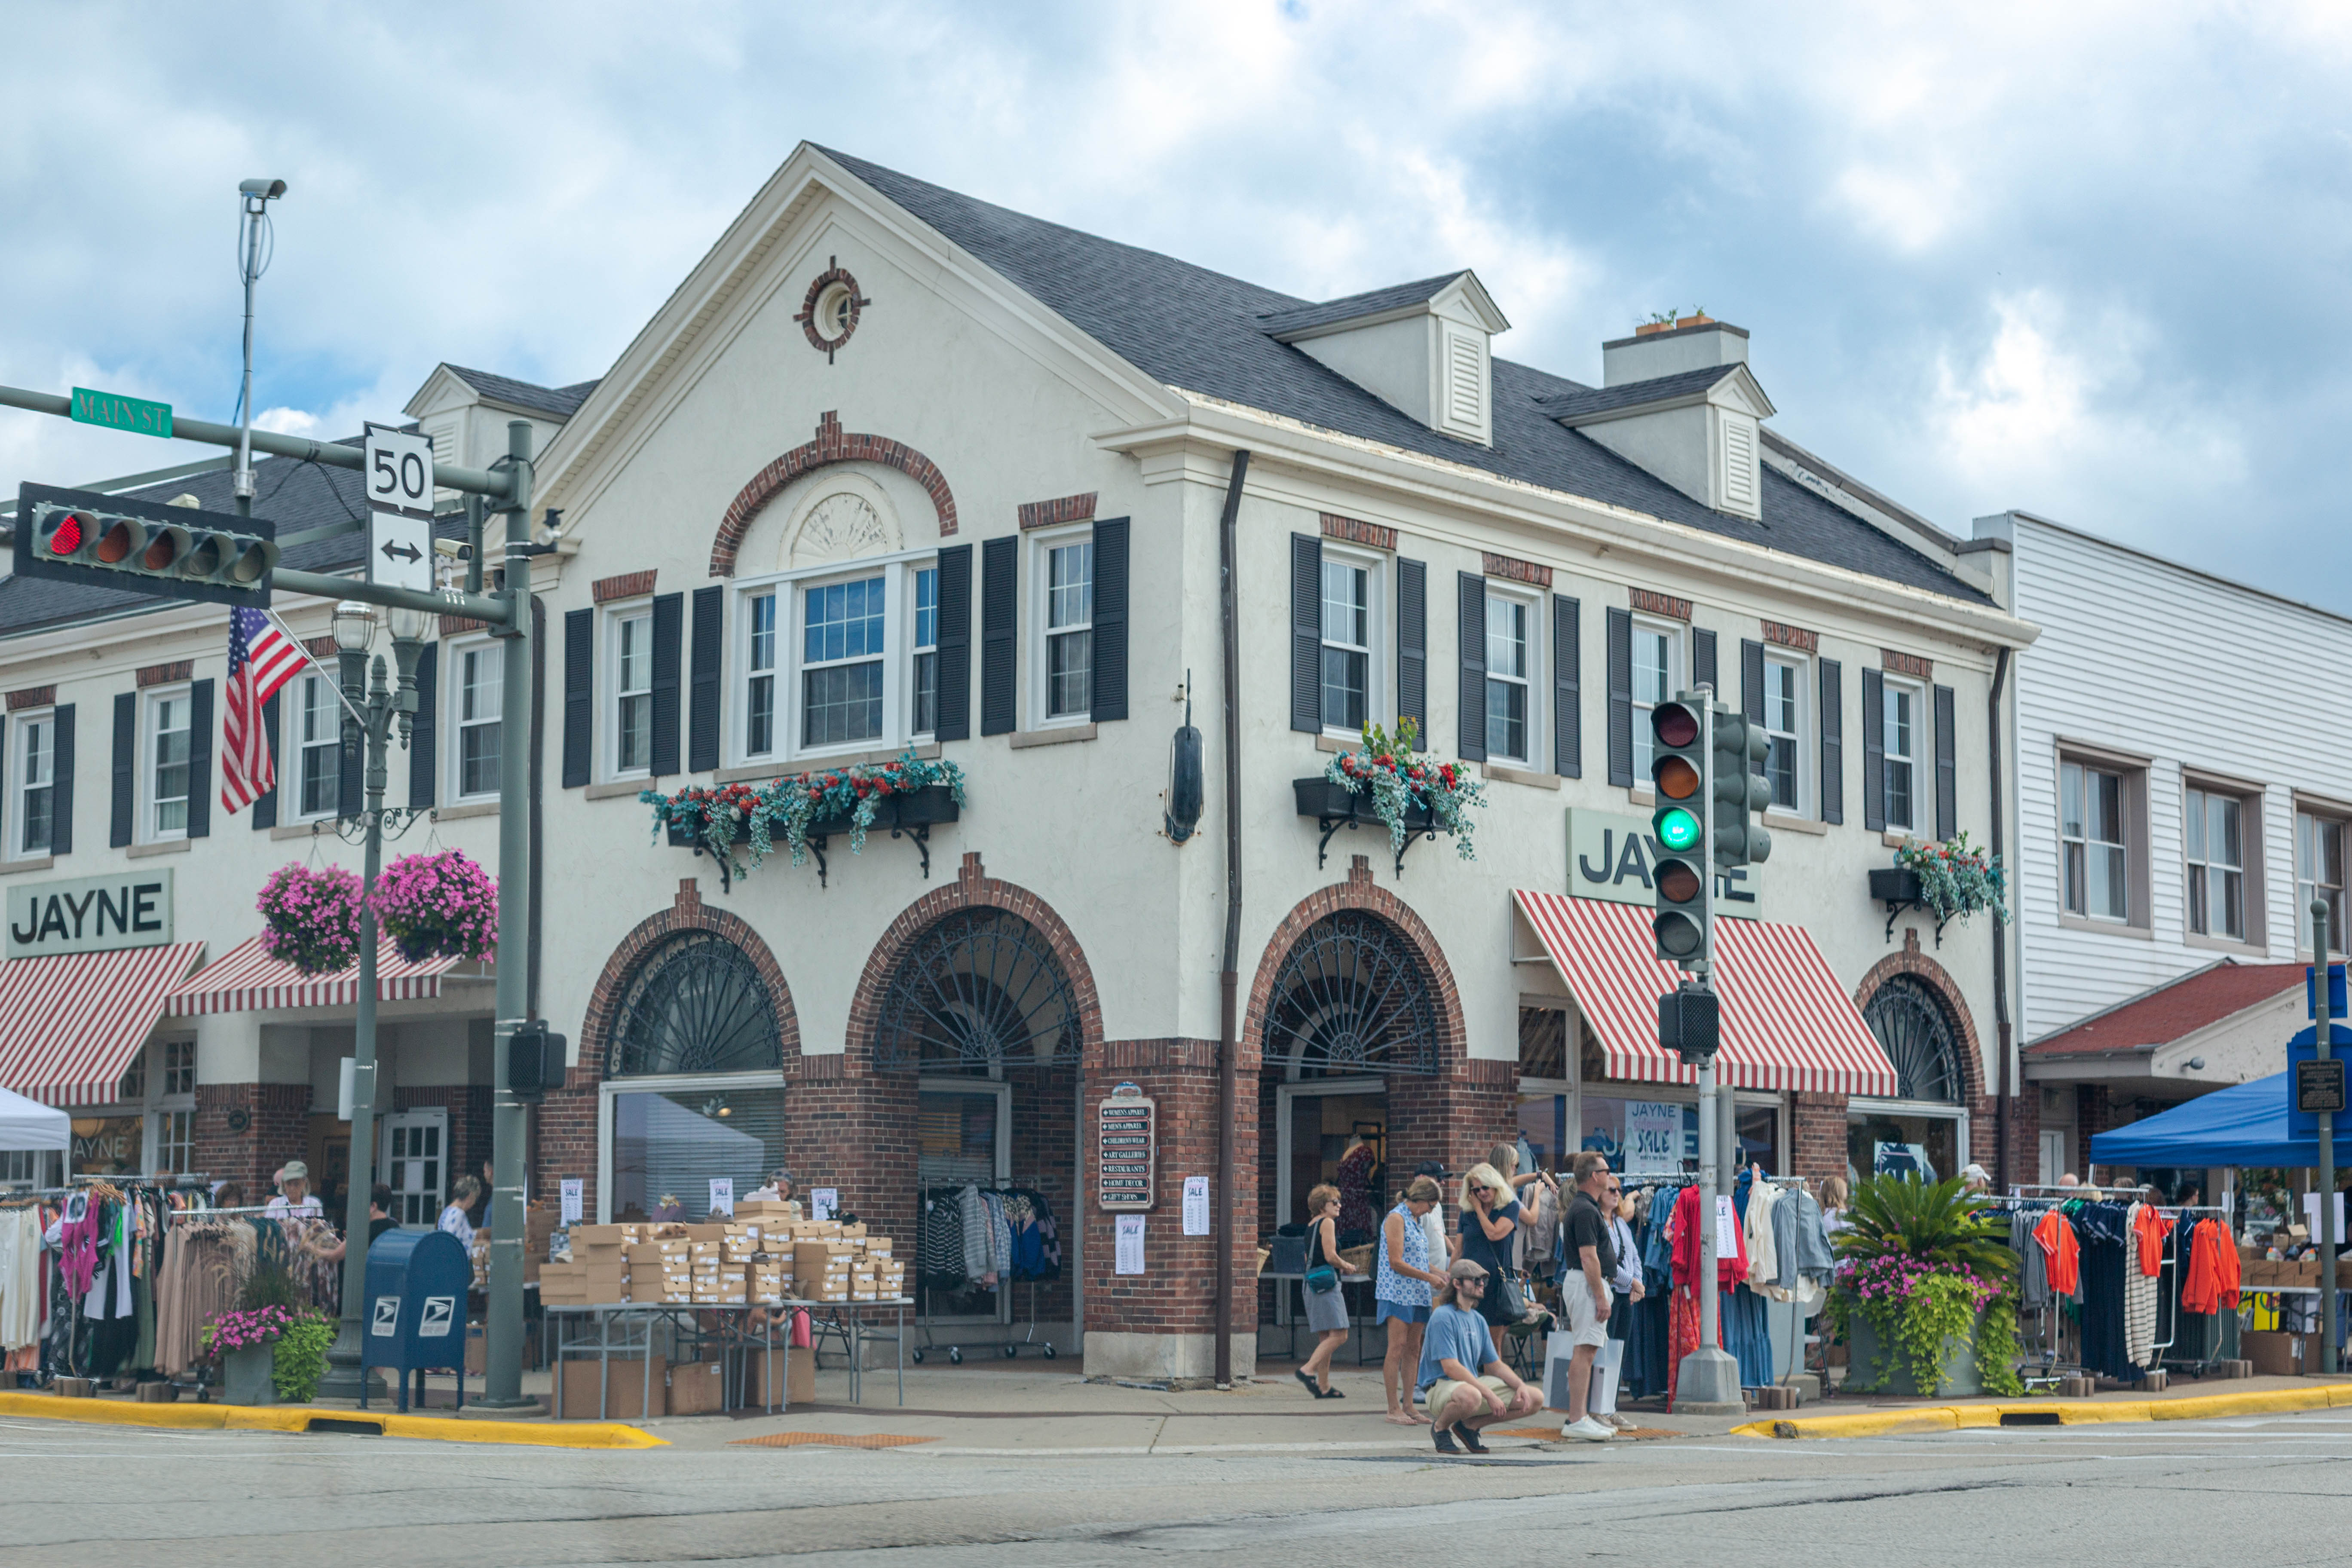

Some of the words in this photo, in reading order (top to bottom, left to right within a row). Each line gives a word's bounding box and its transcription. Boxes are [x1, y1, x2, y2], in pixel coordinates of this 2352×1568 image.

[79, 393, 135, 426] MAIN
[142, 405, 166, 432] ST
[374, 448, 425, 499] 50
[11, 882, 162, 944] JAYNE
[1632, 1103, 1676, 1118] JAYNE
[73, 1136, 128, 1159] AYNE
[1602, 1126, 1699, 1160] JAYNE
[1638, 1128, 1670, 1153] SALE
[565, 1188, 578, 1197] SALE
[715, 1188, 728, 1197] SALE
[1188, 1187, 1203, 1197] SALE
[818, 1198, 832, 1207] SALE
[1122, 1225, 1139, 1235] SALE
